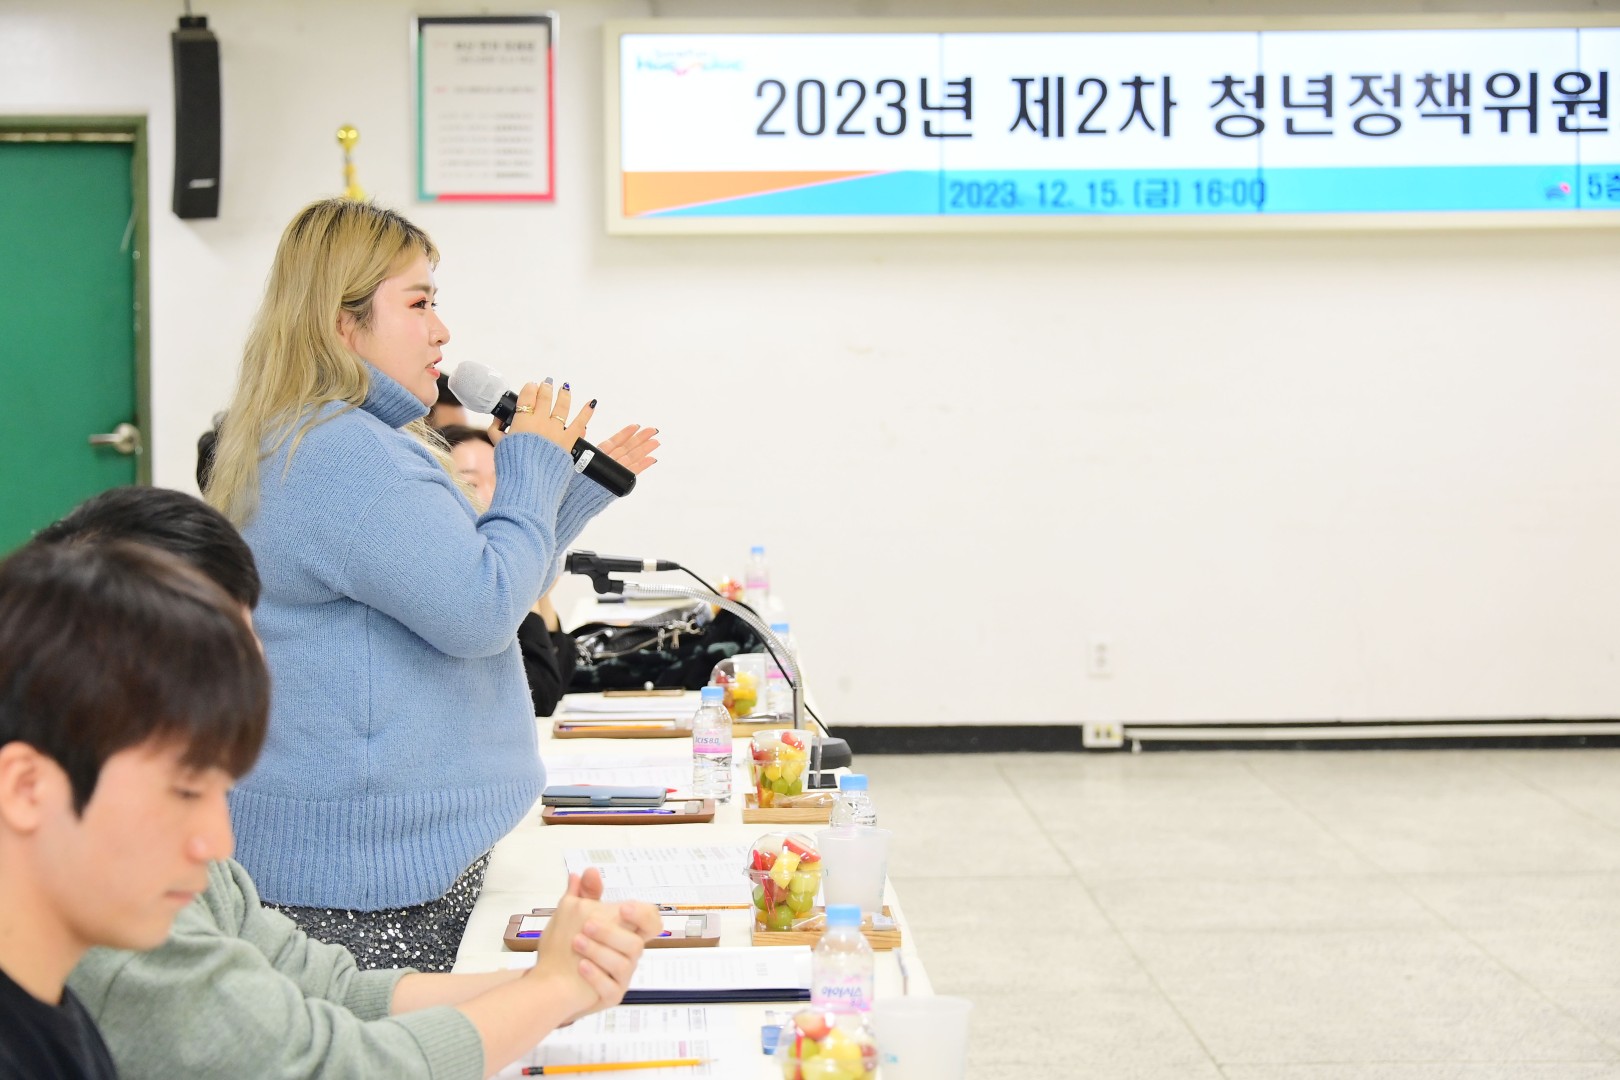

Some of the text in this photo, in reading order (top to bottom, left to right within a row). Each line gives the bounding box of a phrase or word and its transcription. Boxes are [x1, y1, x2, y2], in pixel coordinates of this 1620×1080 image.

[755, 71, 1609, 139] 2023년 제2차 청년정책위원
[950, 180, 1023, 208] 2023.
[1133, 178, 1180, 208] (금)
[1192, 178, 1265, 208] 16:00
